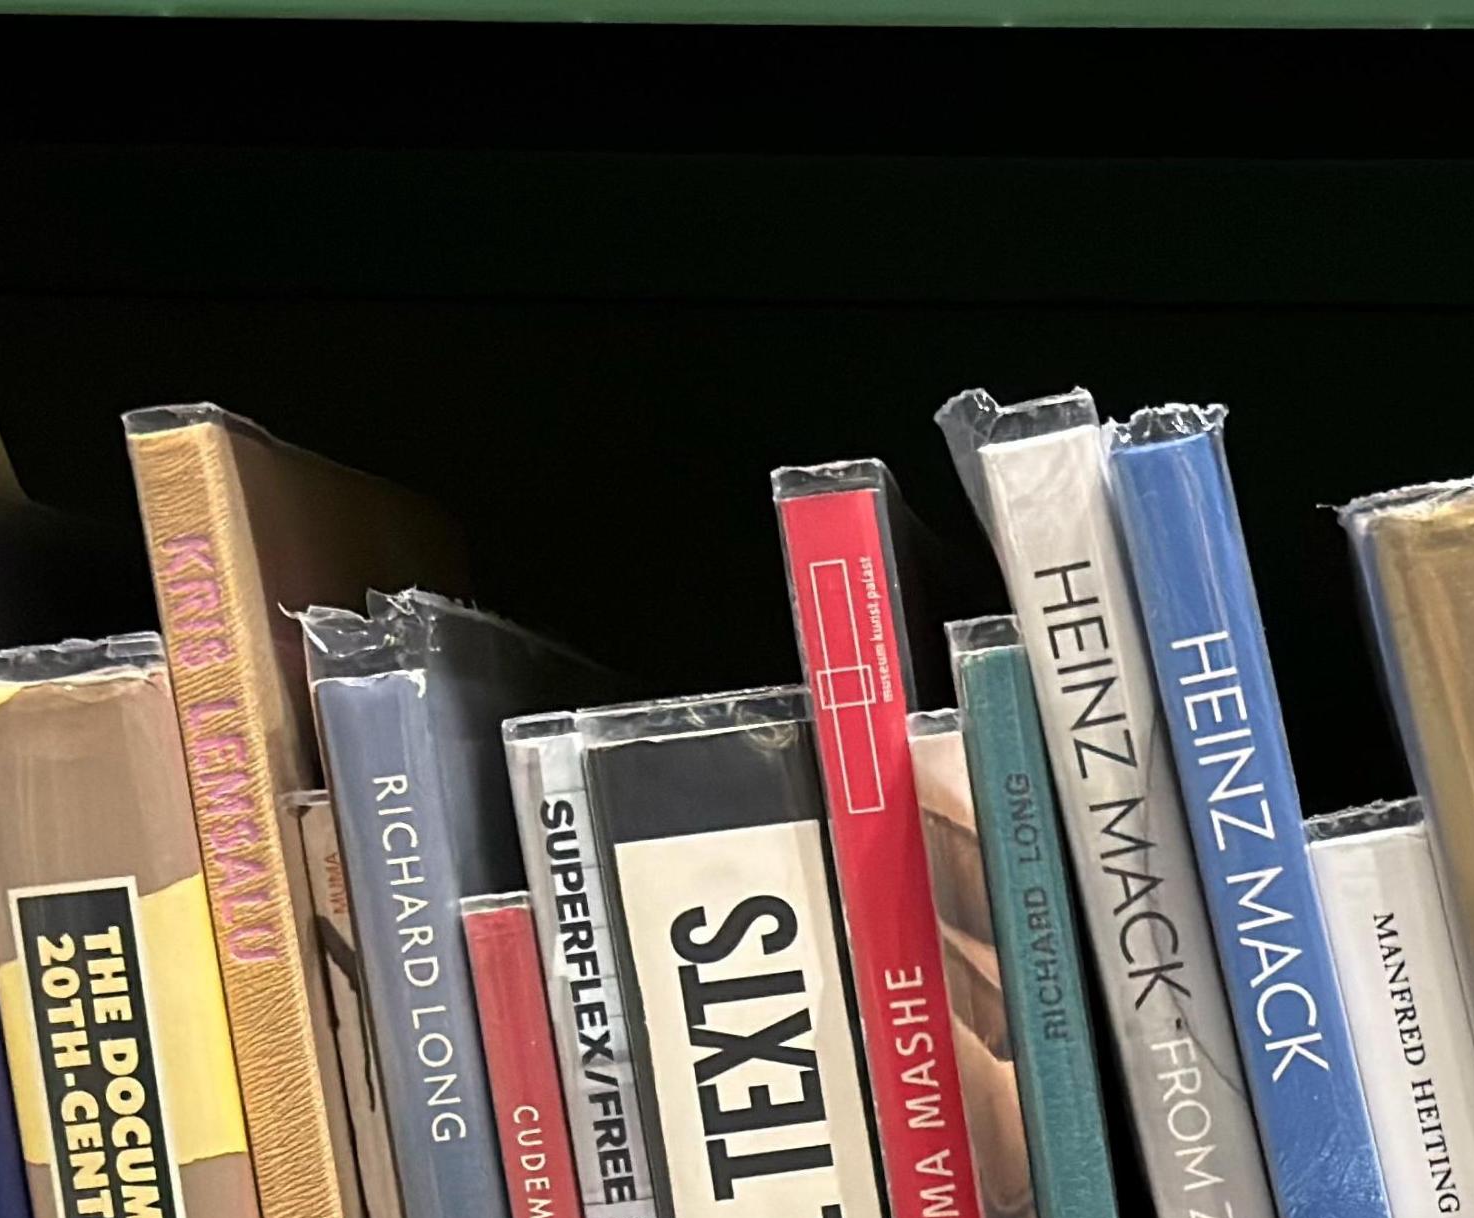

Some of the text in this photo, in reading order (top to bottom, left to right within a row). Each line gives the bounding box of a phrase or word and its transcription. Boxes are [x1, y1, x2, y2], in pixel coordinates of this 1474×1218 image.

[163, 532, 280, 967] KRIS LEMSALU
[1034, 559, 1136, 781] HEINZ
[1087, 797, 1193, 1011] MACK
[1149, 1036, 1225, 1192] FROM
[82, 925, 133, 1025] THE
[372, 772, 468, 1143] RICHARD LONG
[540, 799, 636, 1206] SUPERFLEX/FREE
[670, 894, 832, 1201] TEXTS
[886, 964, 950, 1129] MASHE
[1005, 772, 1071, 1043] RICHARD LONG
[1373, 912, 1461, 1216] MANFRED HEITING
